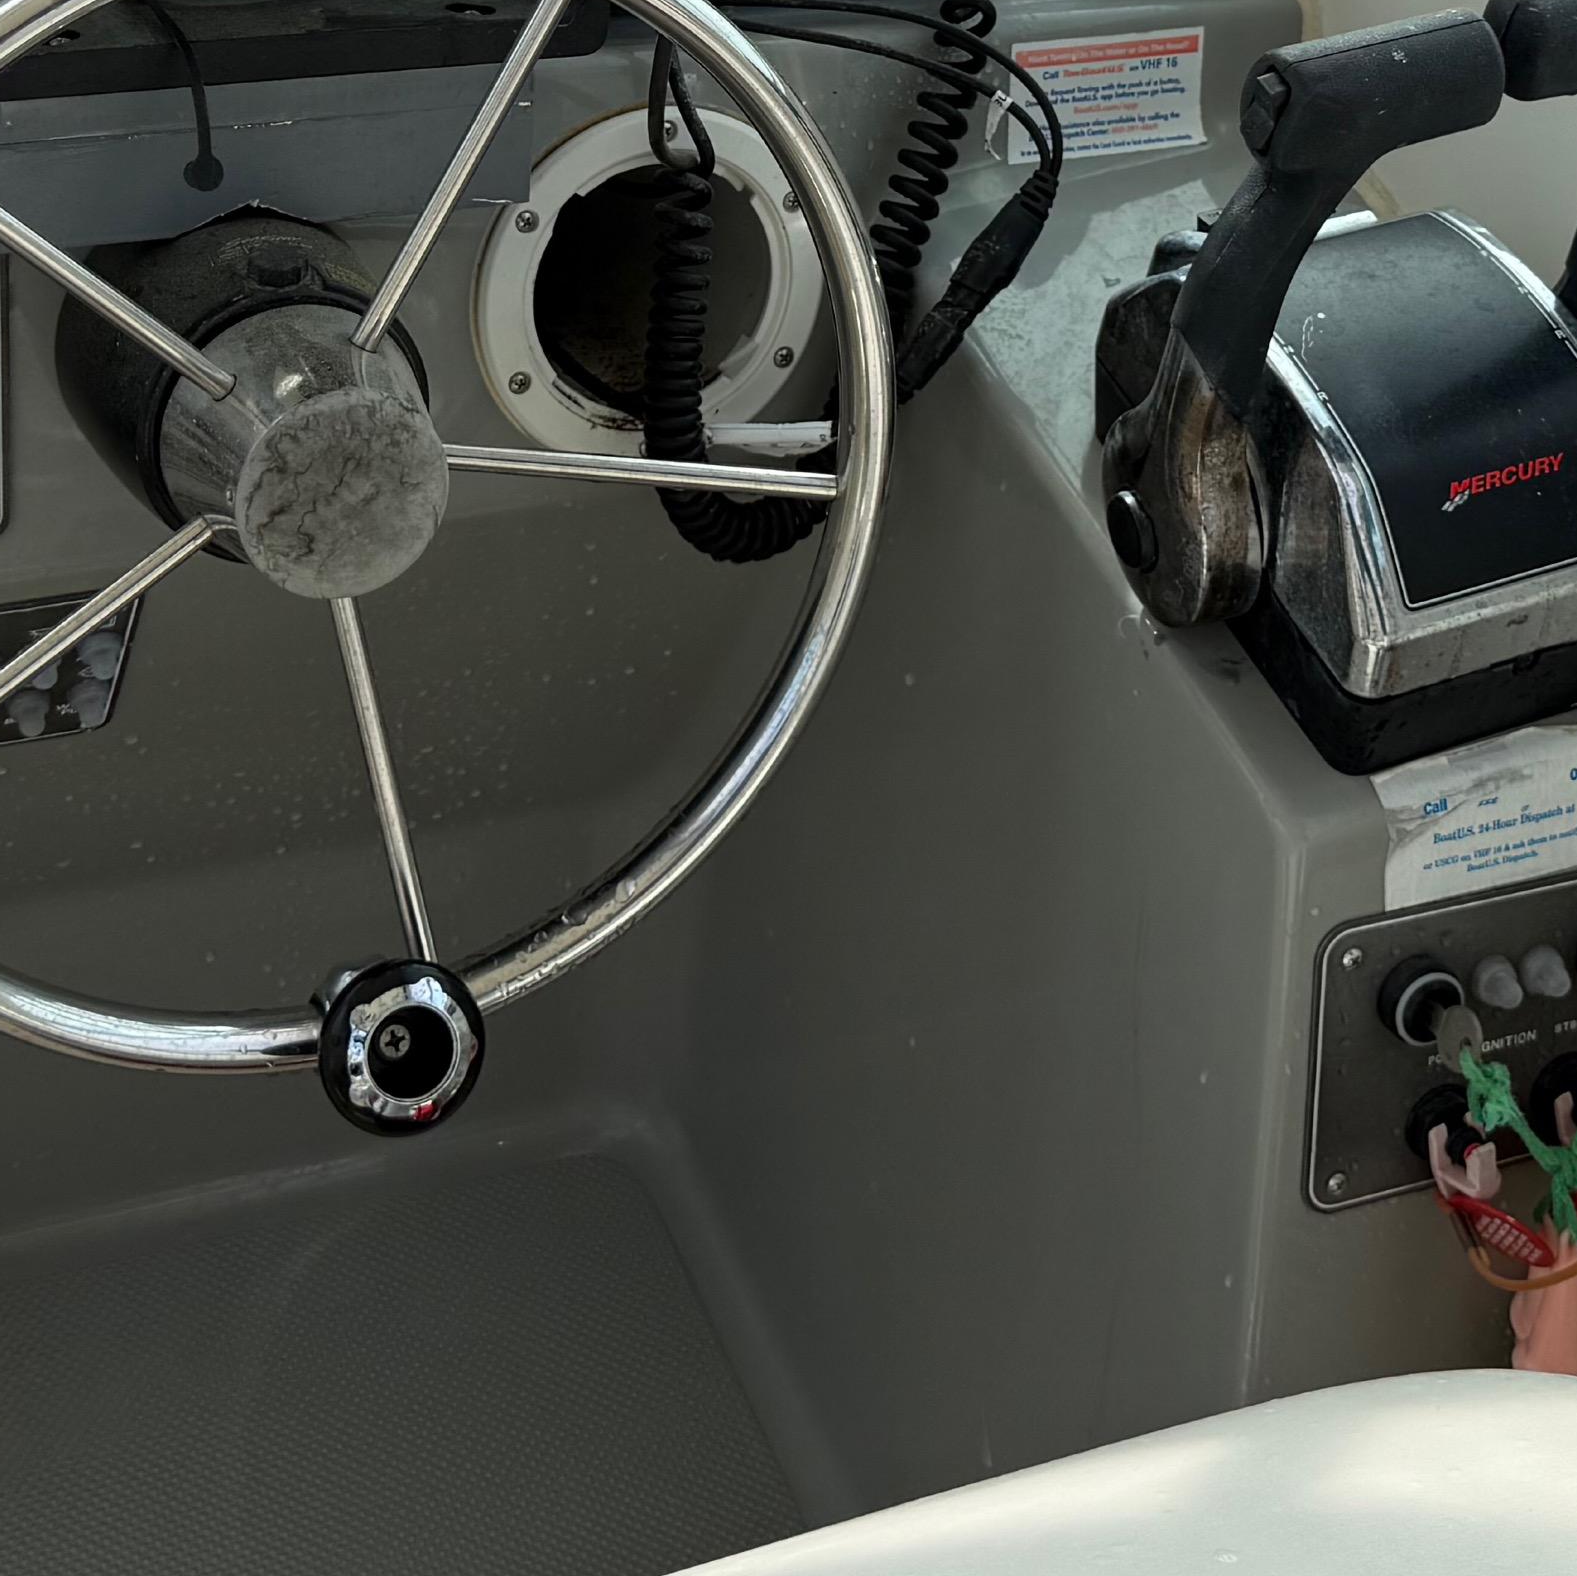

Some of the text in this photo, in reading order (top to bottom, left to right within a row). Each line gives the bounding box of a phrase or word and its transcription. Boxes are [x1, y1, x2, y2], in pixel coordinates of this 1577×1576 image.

[1043, 71, 1059, 80] Call
[1140, 58, 1162, 70] VHF
[1450, 452, 1564, 498] MERCURY
[1423, 797, 1448, 815] Call
[1520, 806, 1563, 824] Dispatch
[1565, 803, 1576, 814] at
[1481, 1029, 1536, 1052] GNITION
